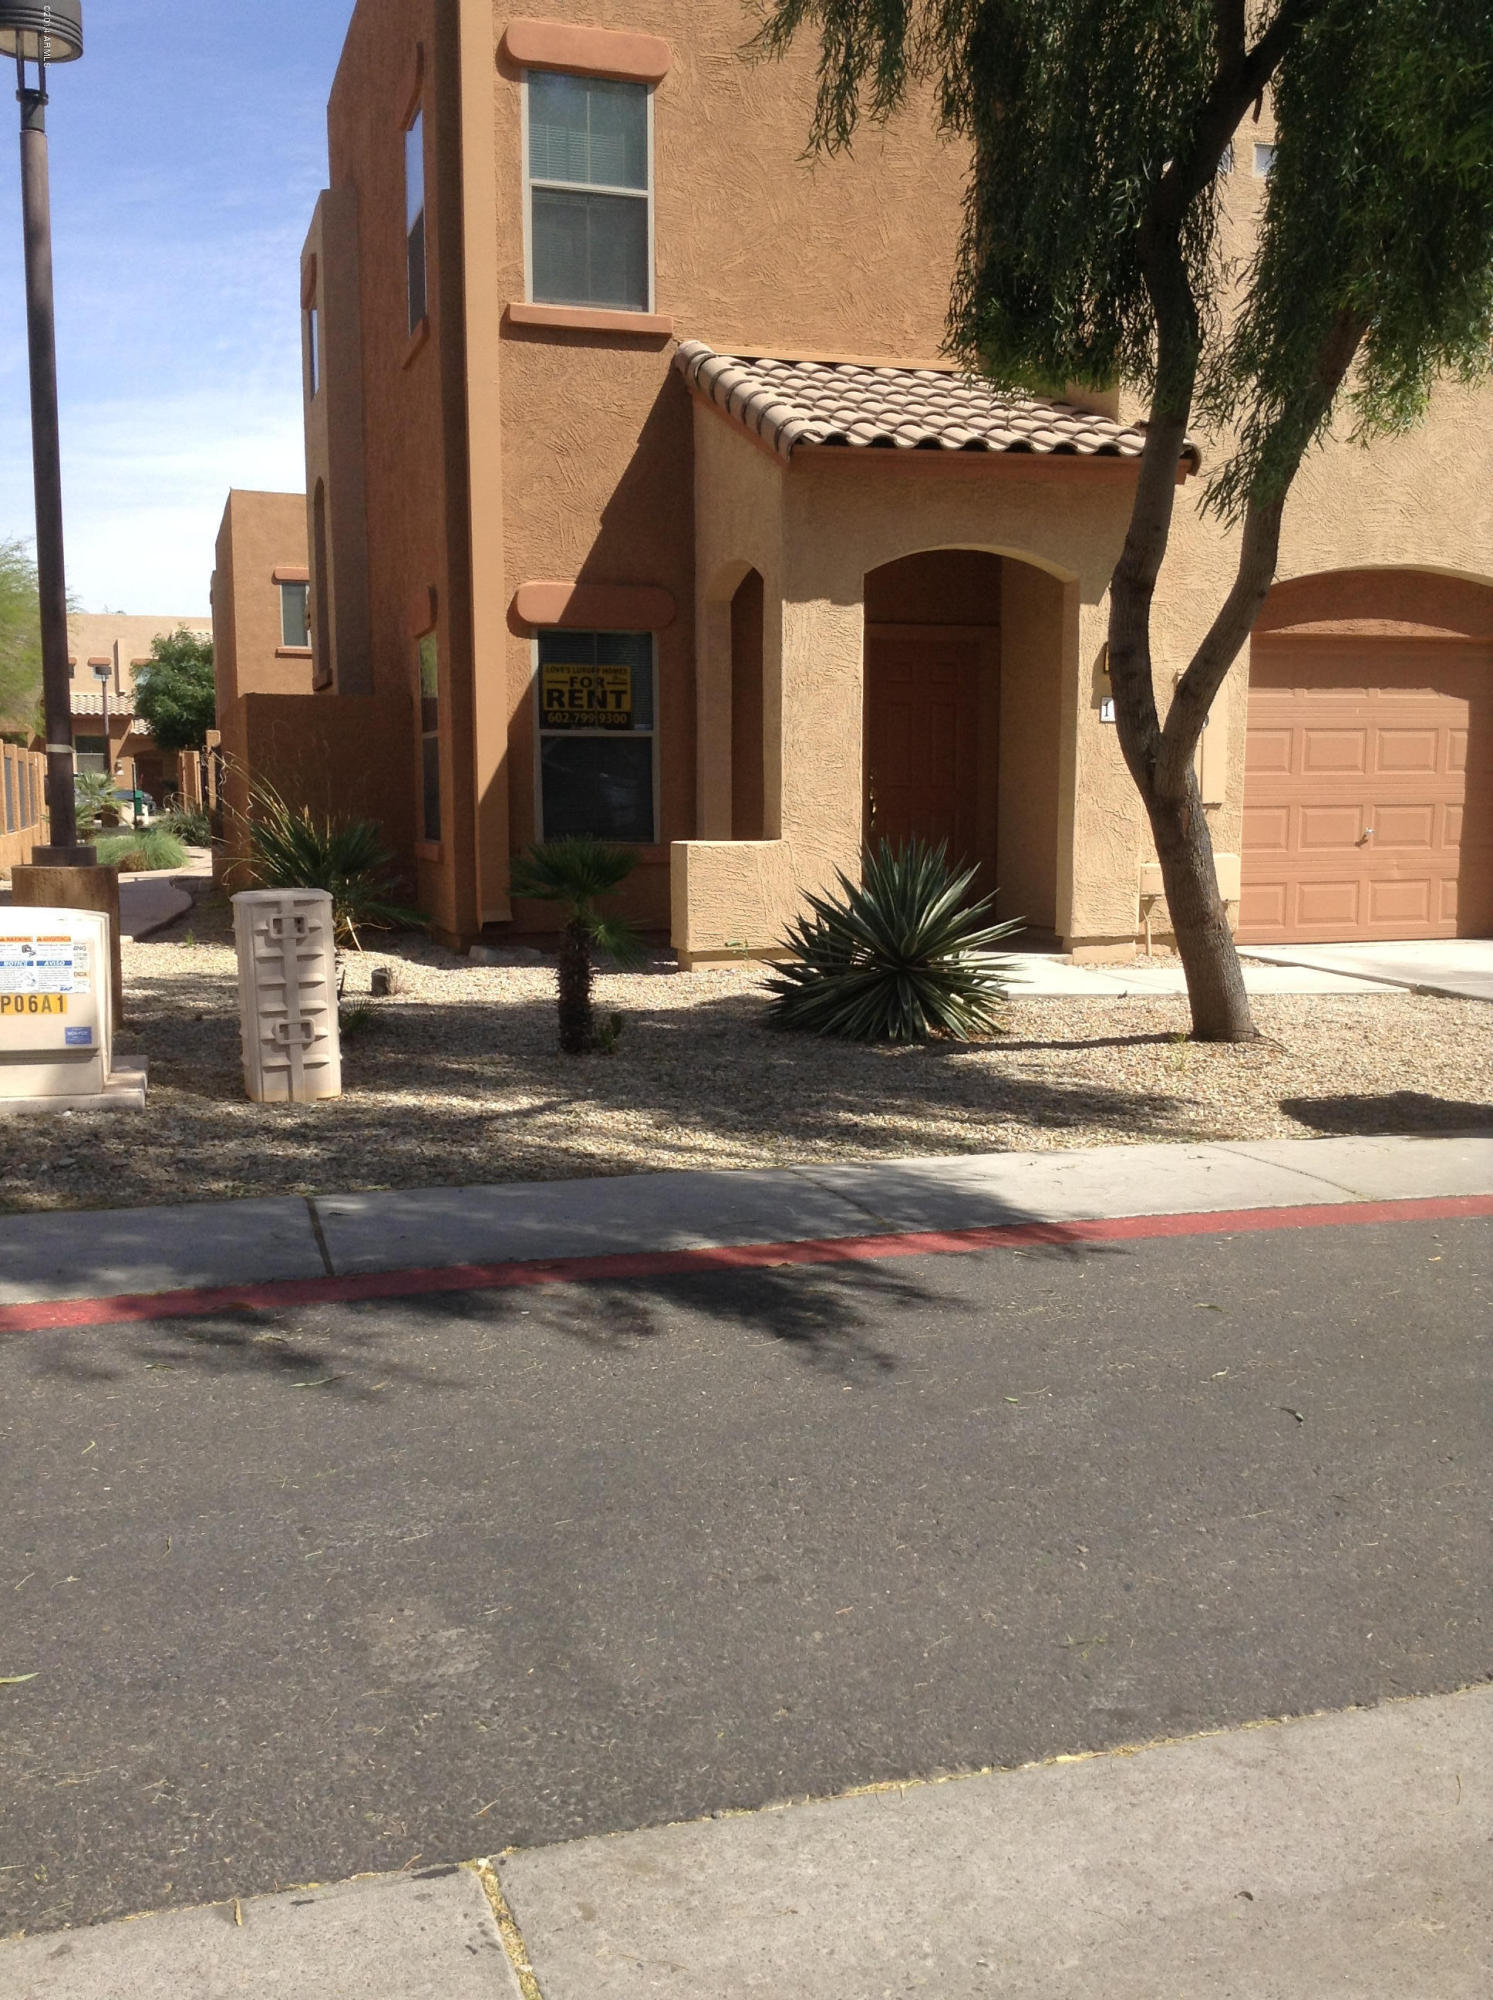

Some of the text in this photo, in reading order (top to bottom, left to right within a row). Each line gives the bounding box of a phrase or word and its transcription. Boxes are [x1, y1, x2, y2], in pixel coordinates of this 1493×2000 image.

[569, 676, 605, 688] FOR
[546, 687, 628, 709] RENT
[547, 711, 569, 724] 602
[0, 994, 64, 1013] P06A1
